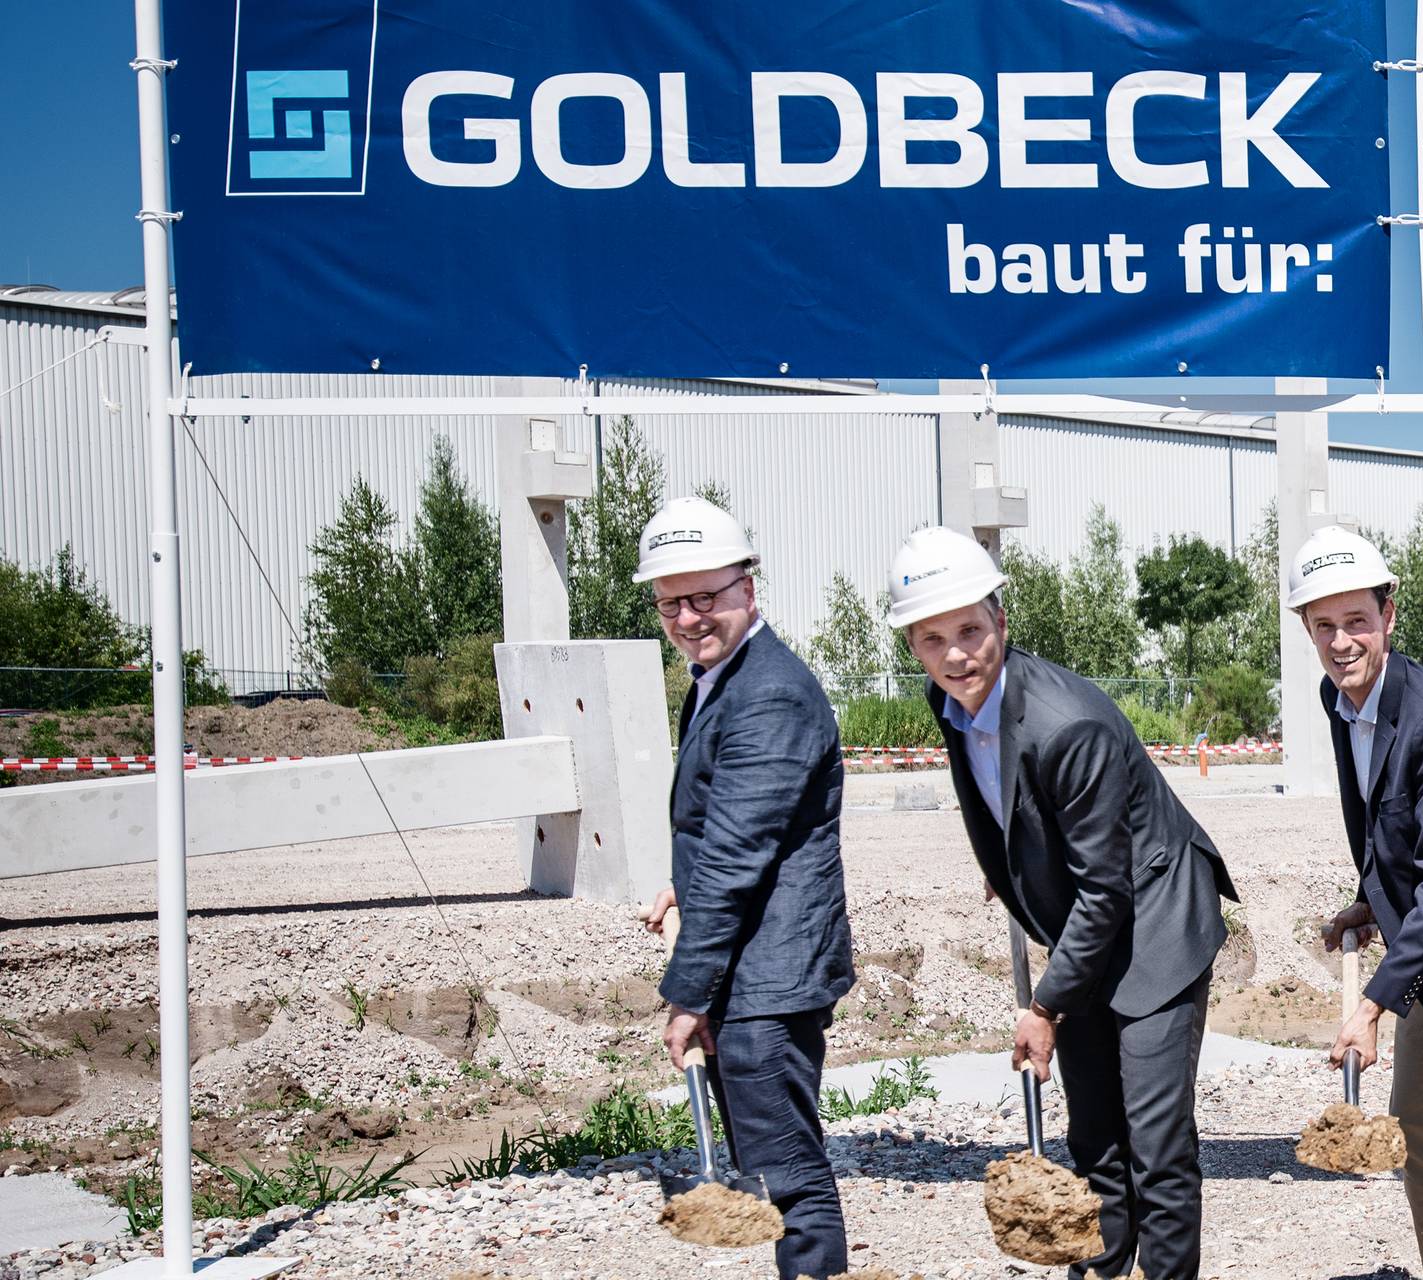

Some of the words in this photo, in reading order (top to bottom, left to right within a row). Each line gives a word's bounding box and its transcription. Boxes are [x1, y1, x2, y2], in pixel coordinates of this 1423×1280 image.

[401, 70, 1331, 190] GOLDBECK
[946, 223, 1147, 294] baut
[1178, 223, 1335, 294] für:
